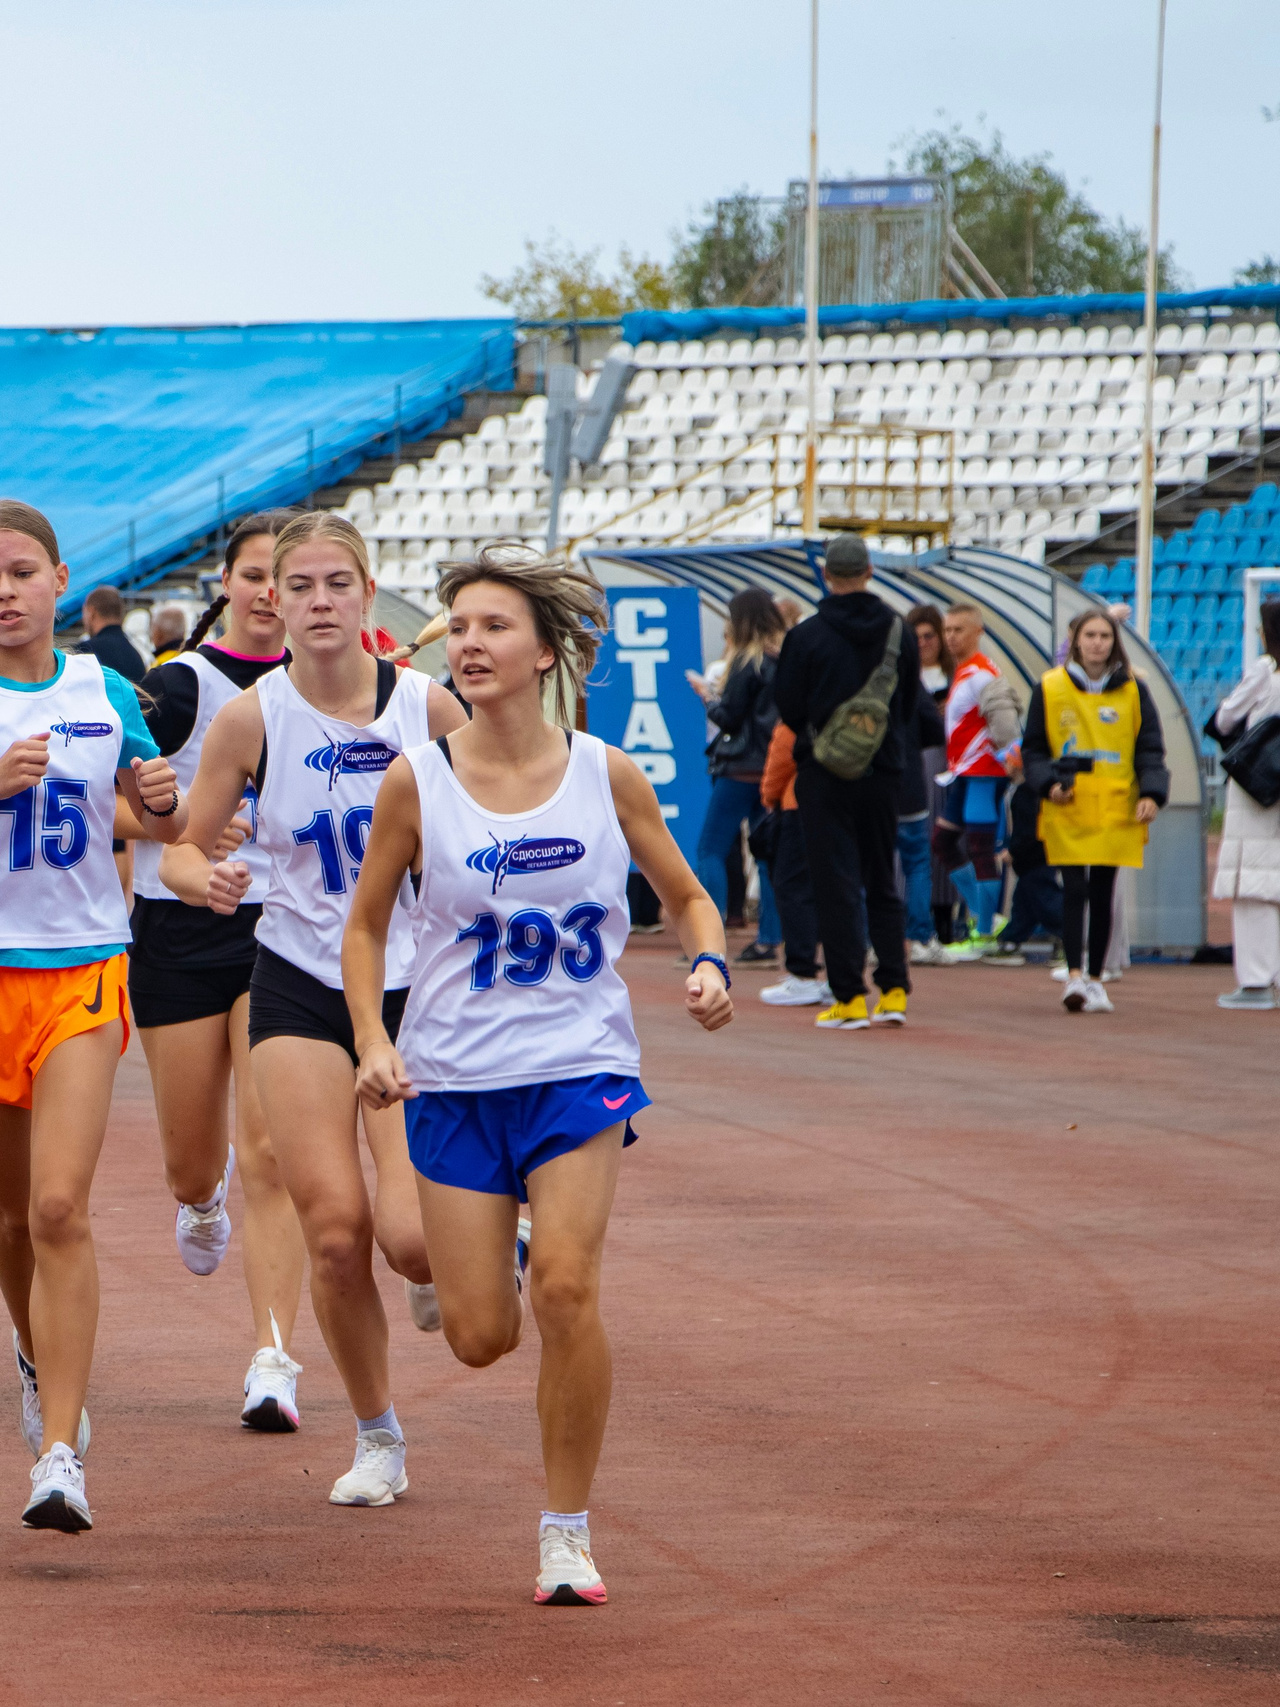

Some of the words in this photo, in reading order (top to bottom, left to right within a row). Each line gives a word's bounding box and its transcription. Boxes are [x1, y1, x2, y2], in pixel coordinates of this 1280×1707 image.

[614, 598, 679, 819] СТАР
[345, 751, 391, 762] СДЮСШОР
[512, 846, 564, 861] СДЮСШОР
[578, 843, 583, 853] 3
[456, 902, 608, 991] 193
